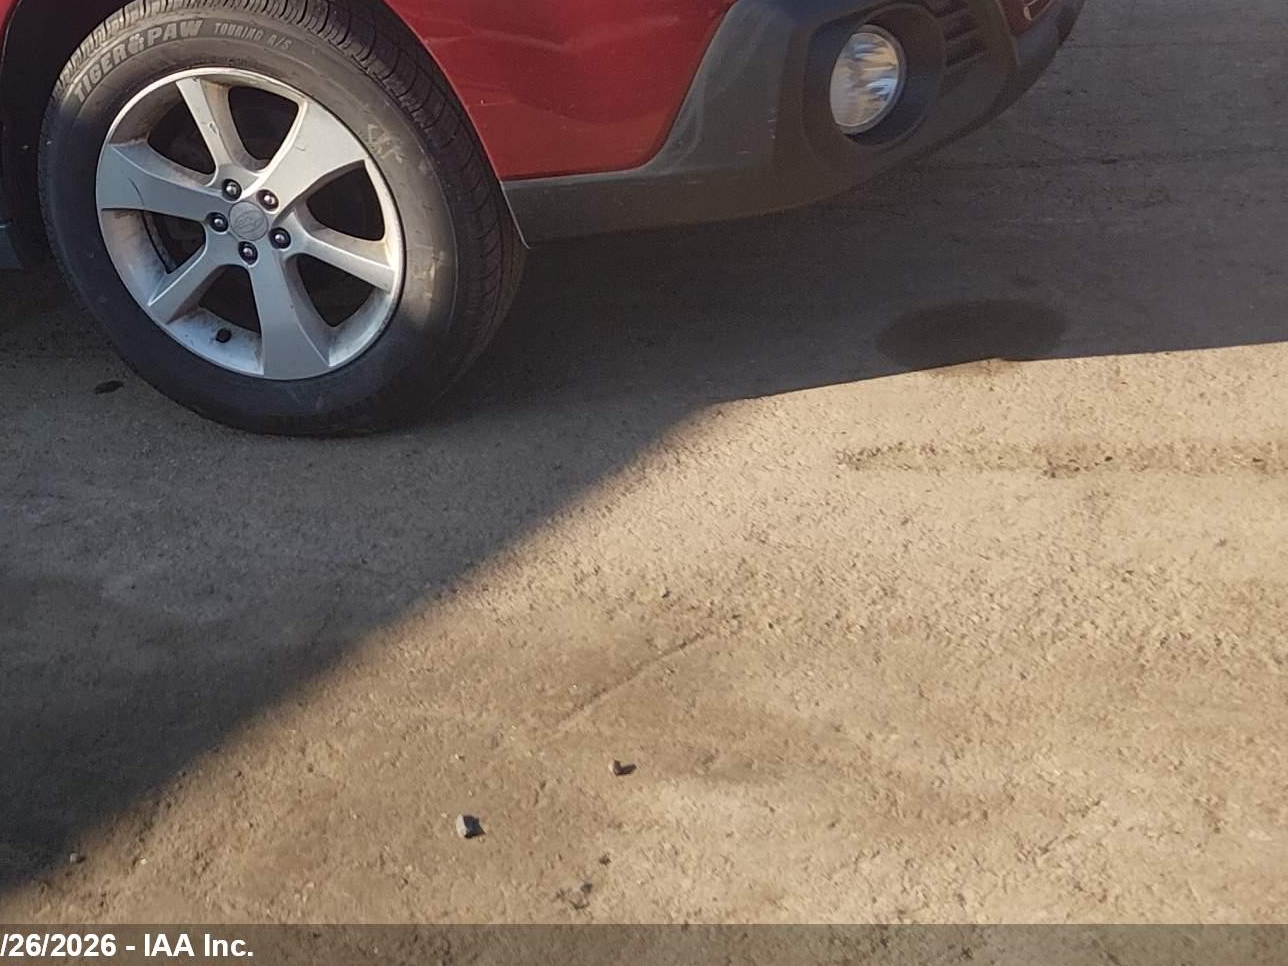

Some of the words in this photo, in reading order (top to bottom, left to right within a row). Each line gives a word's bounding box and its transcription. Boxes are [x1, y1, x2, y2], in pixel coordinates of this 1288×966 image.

[74, 43, 128, 103] TIGER
[146, 19, 203, 47] PAW
[214, 21, 265, 43] TOURING
